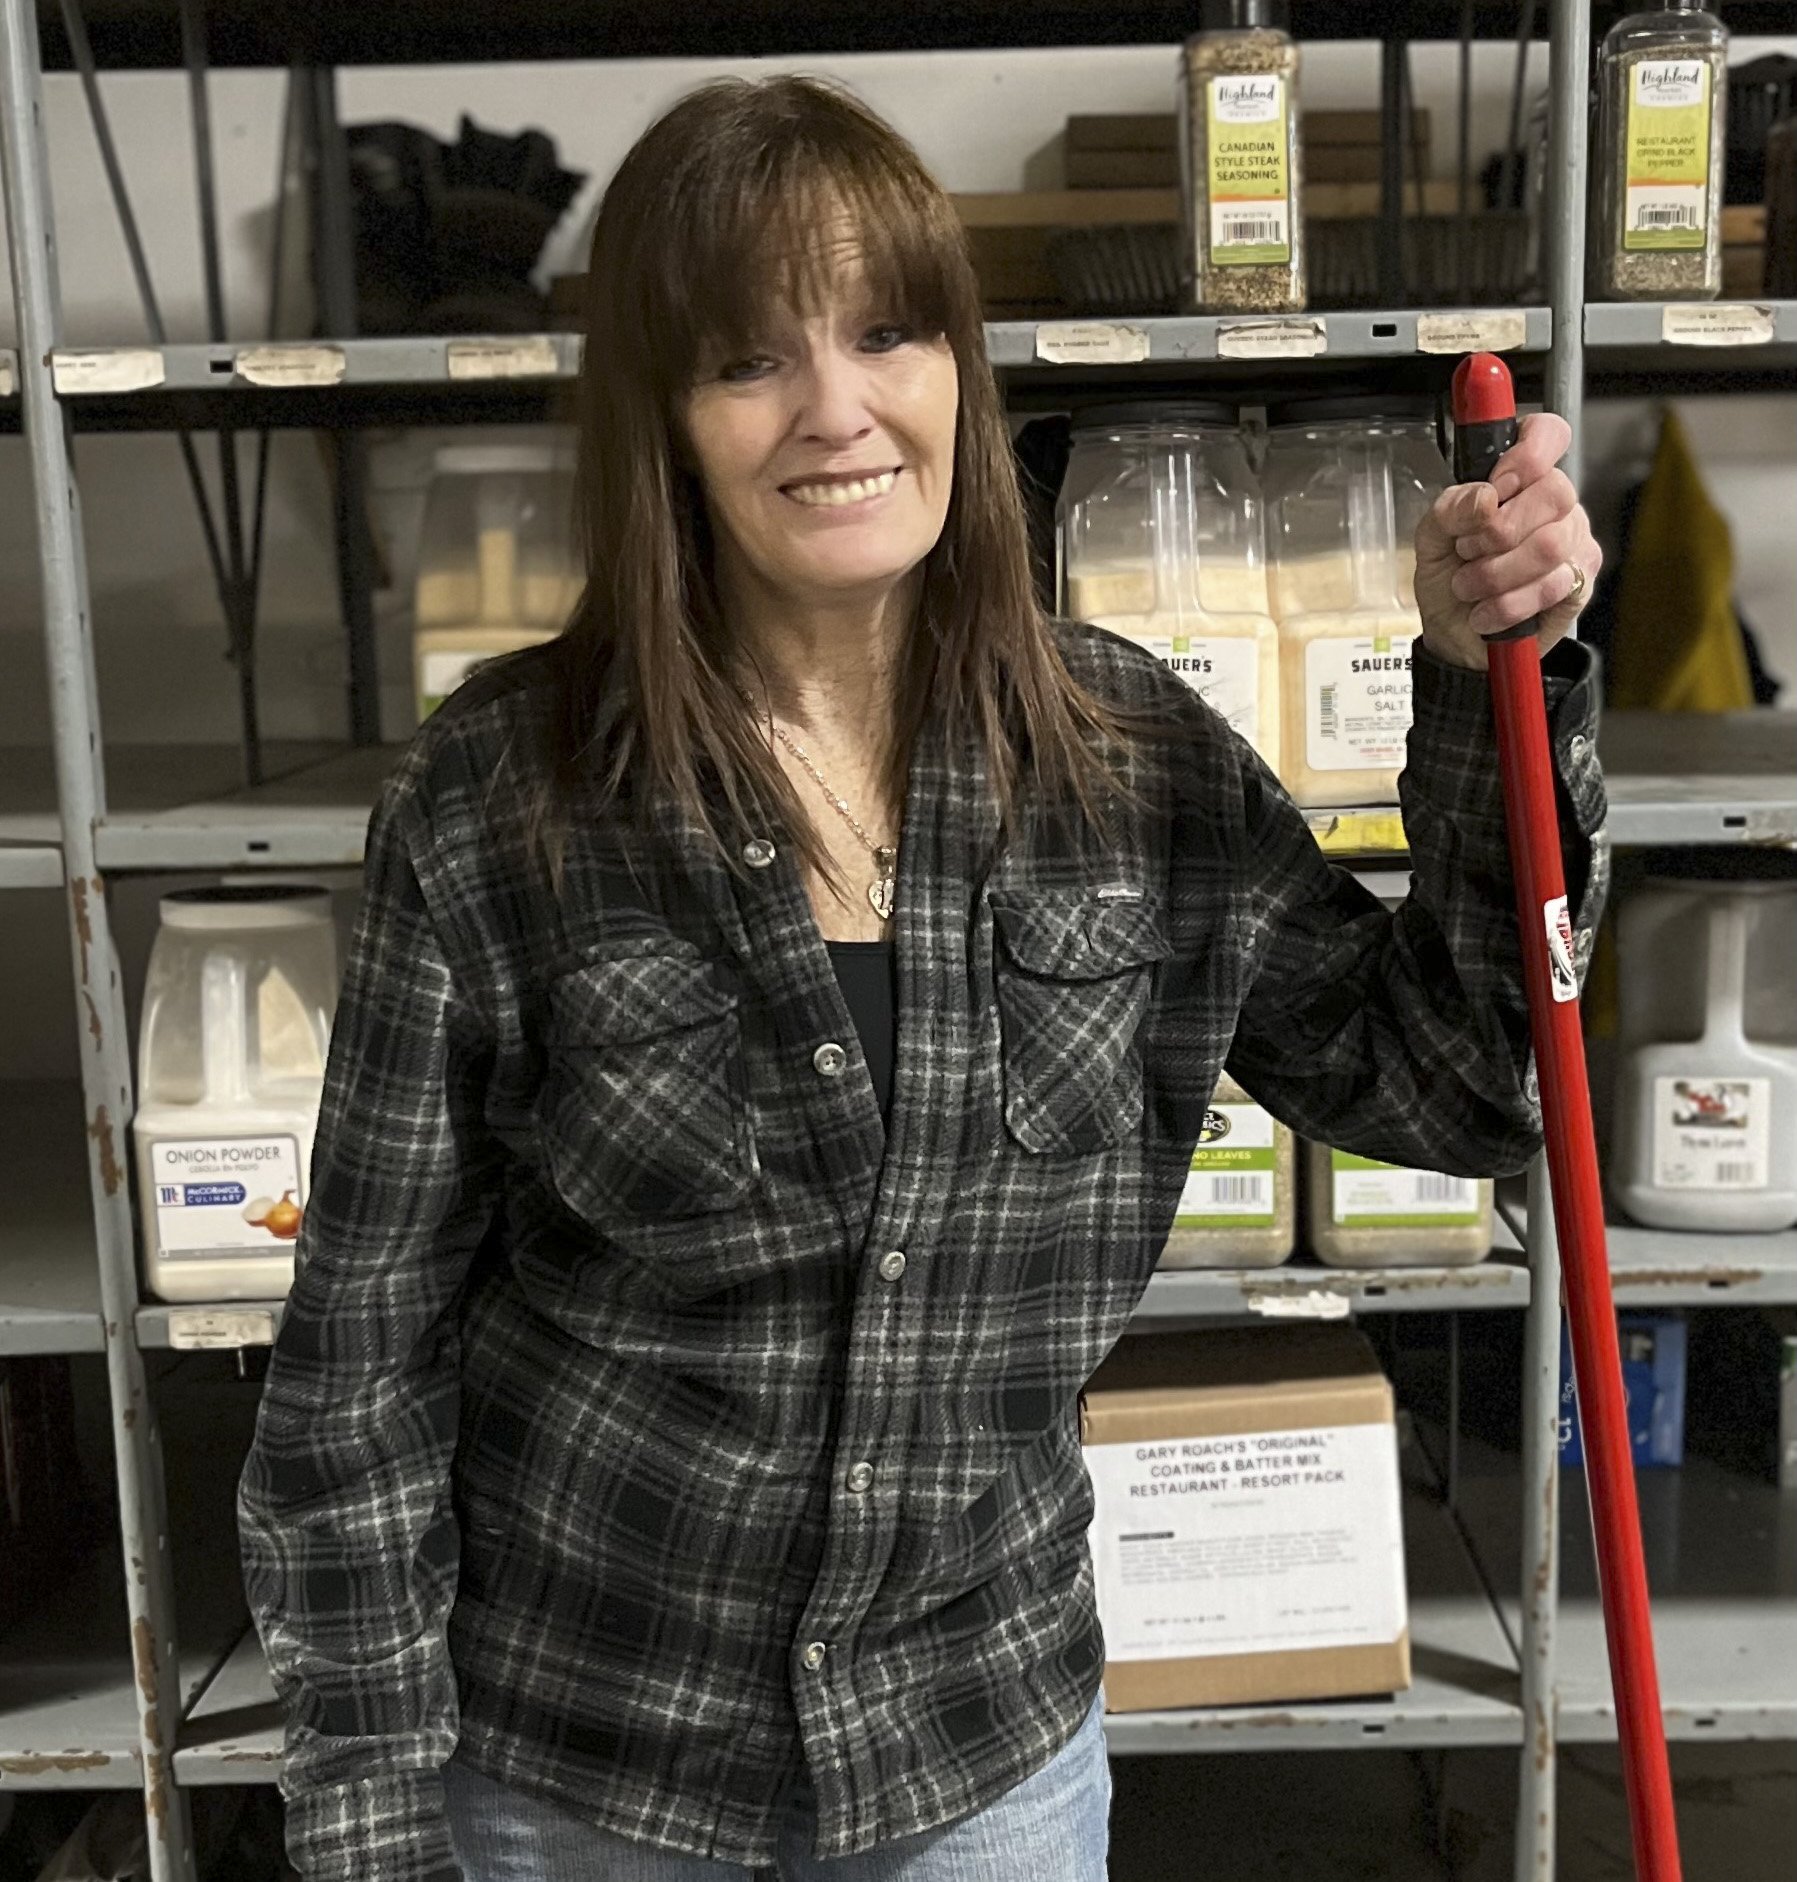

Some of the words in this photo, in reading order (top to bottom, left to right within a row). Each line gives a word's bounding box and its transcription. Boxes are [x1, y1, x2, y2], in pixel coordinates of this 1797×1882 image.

[1639, 66, 1700, 90] Highland
[1219, 83, 1275, 105] Highland
[1636, 135, 1697, 146] RESTAURANT
[1219, 142, 1275, 153] CANADIAN
[1214, 156, 1245, 168] STYLE
[1247, 156, 1280, 167] STEAK
[1216, 169, 1279, 181] SEASONING
[1366, 684, 1412, 696] GARLIC
[1374, 701, 1405, 712] SALT
[165, 1150, 217, 1164] ONION
[220, 1146, 280, 1162] POWDER
[1210, 1150, 1252, 1160] LEAVES
[186, 1194, 241, 1204] CULINARY
[1136, 1446, 1177, 1461] GARY
[1182, 1440, 1247, 1456] ROACH'S
[1150, 1460, 1217, 1478] COATING
[1221, 1460, 1230, 1472] &
[1235, 1455, 1292, 1472] BATTER
[1297, 1453, 1322, 1466] MIX
[1130, 1478, 1228, 1497] RESTAURANT
[1241, 1472, 1300, 1488] RESORT
[1304, 1469, 1345, 1483] PACK
